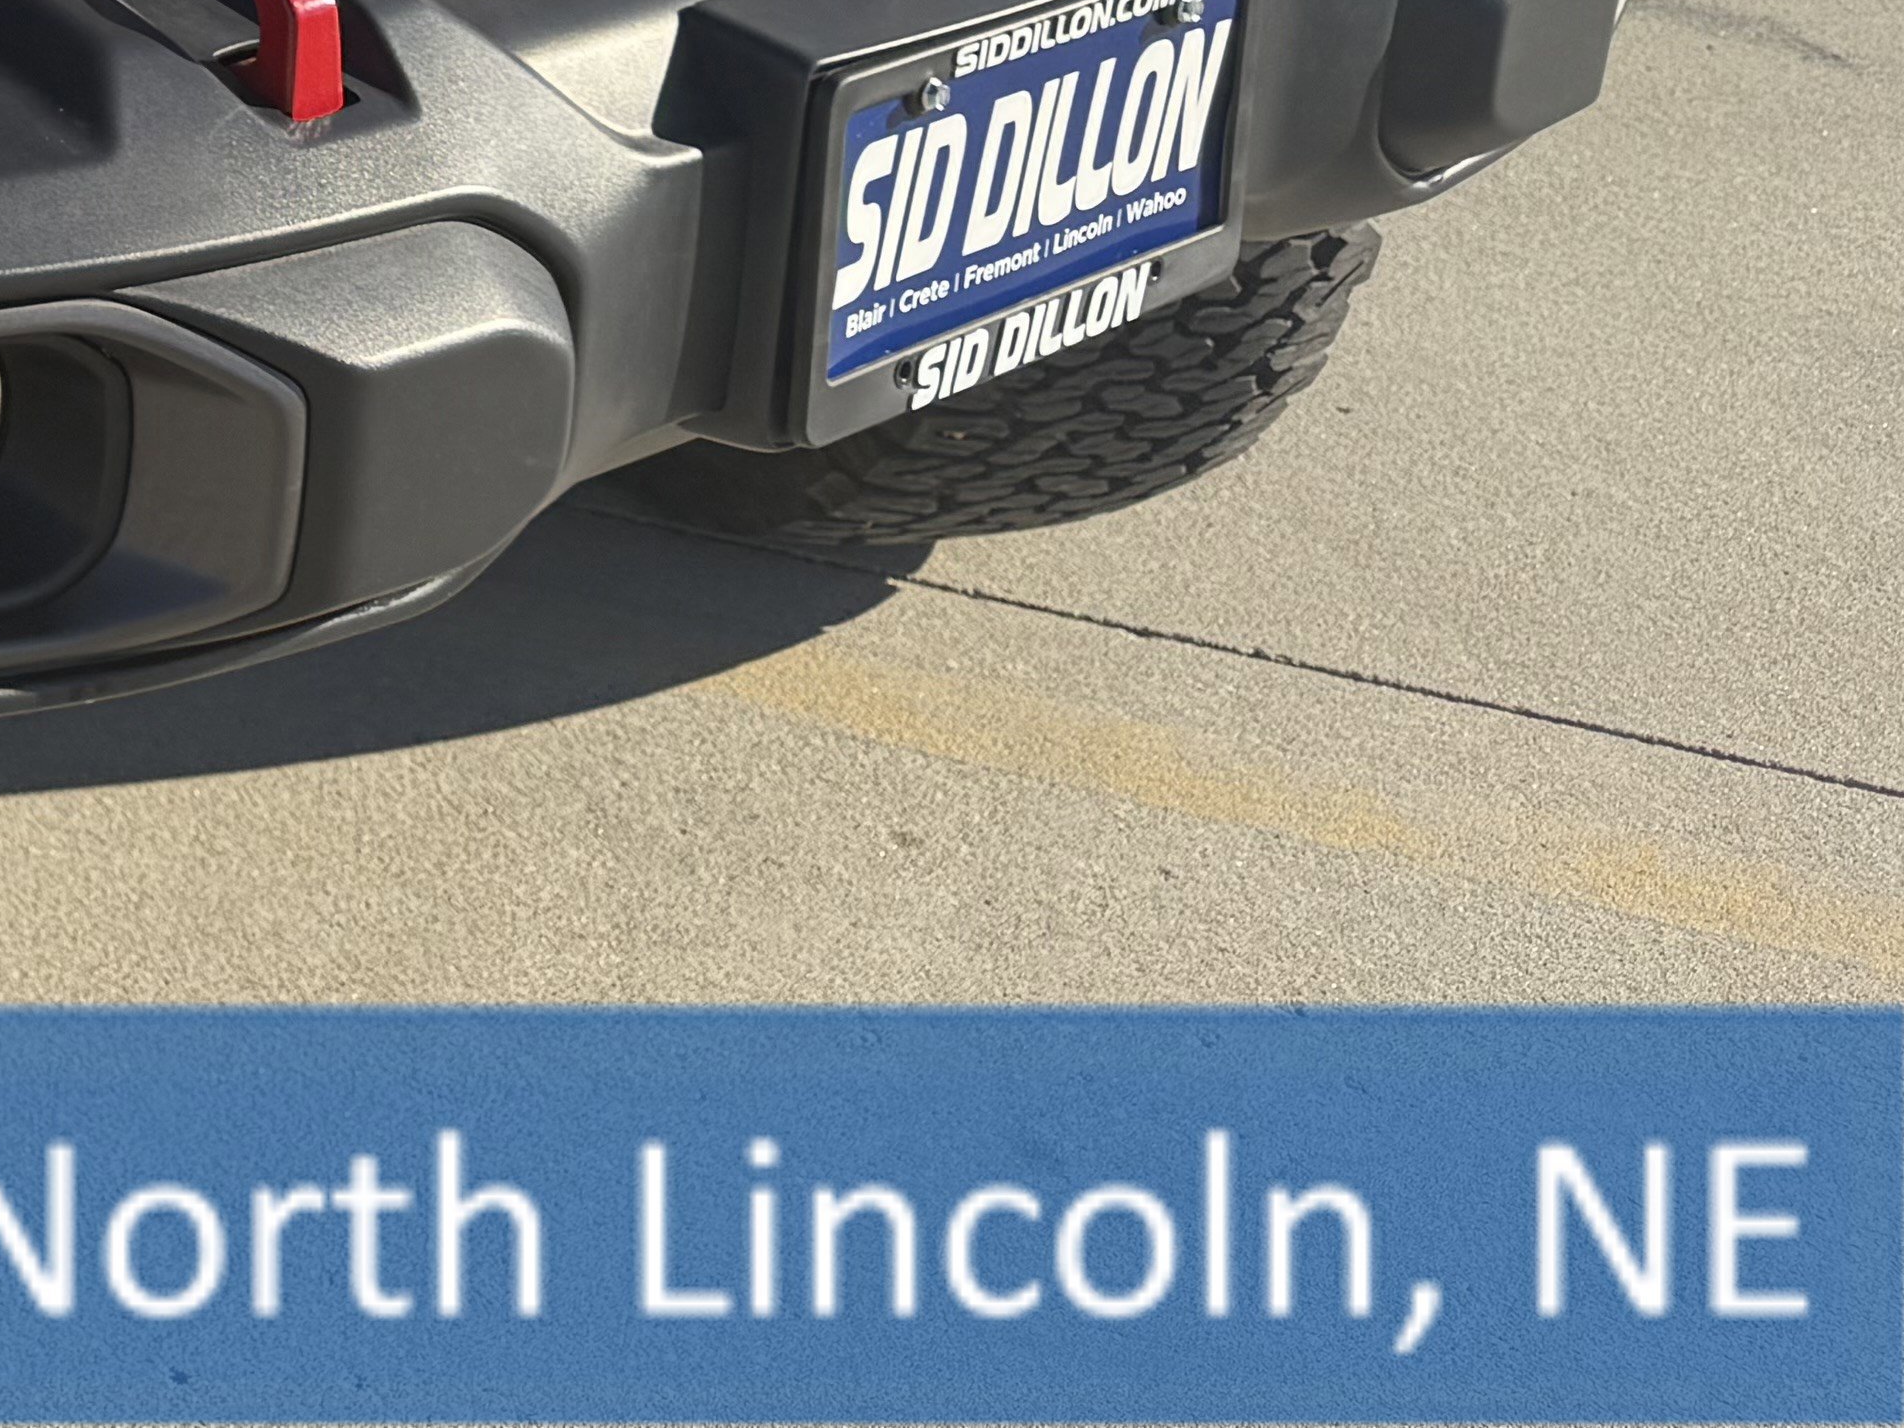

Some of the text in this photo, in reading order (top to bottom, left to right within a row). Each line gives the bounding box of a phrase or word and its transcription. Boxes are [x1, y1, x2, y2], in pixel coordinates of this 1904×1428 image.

[832, 18, 1232, 311] SID DILLON
[845, 187, 1187, 338] Blair Crete Fremont Lincoln Wahoo
[910, 261, 1152, 411] SID DILLON
